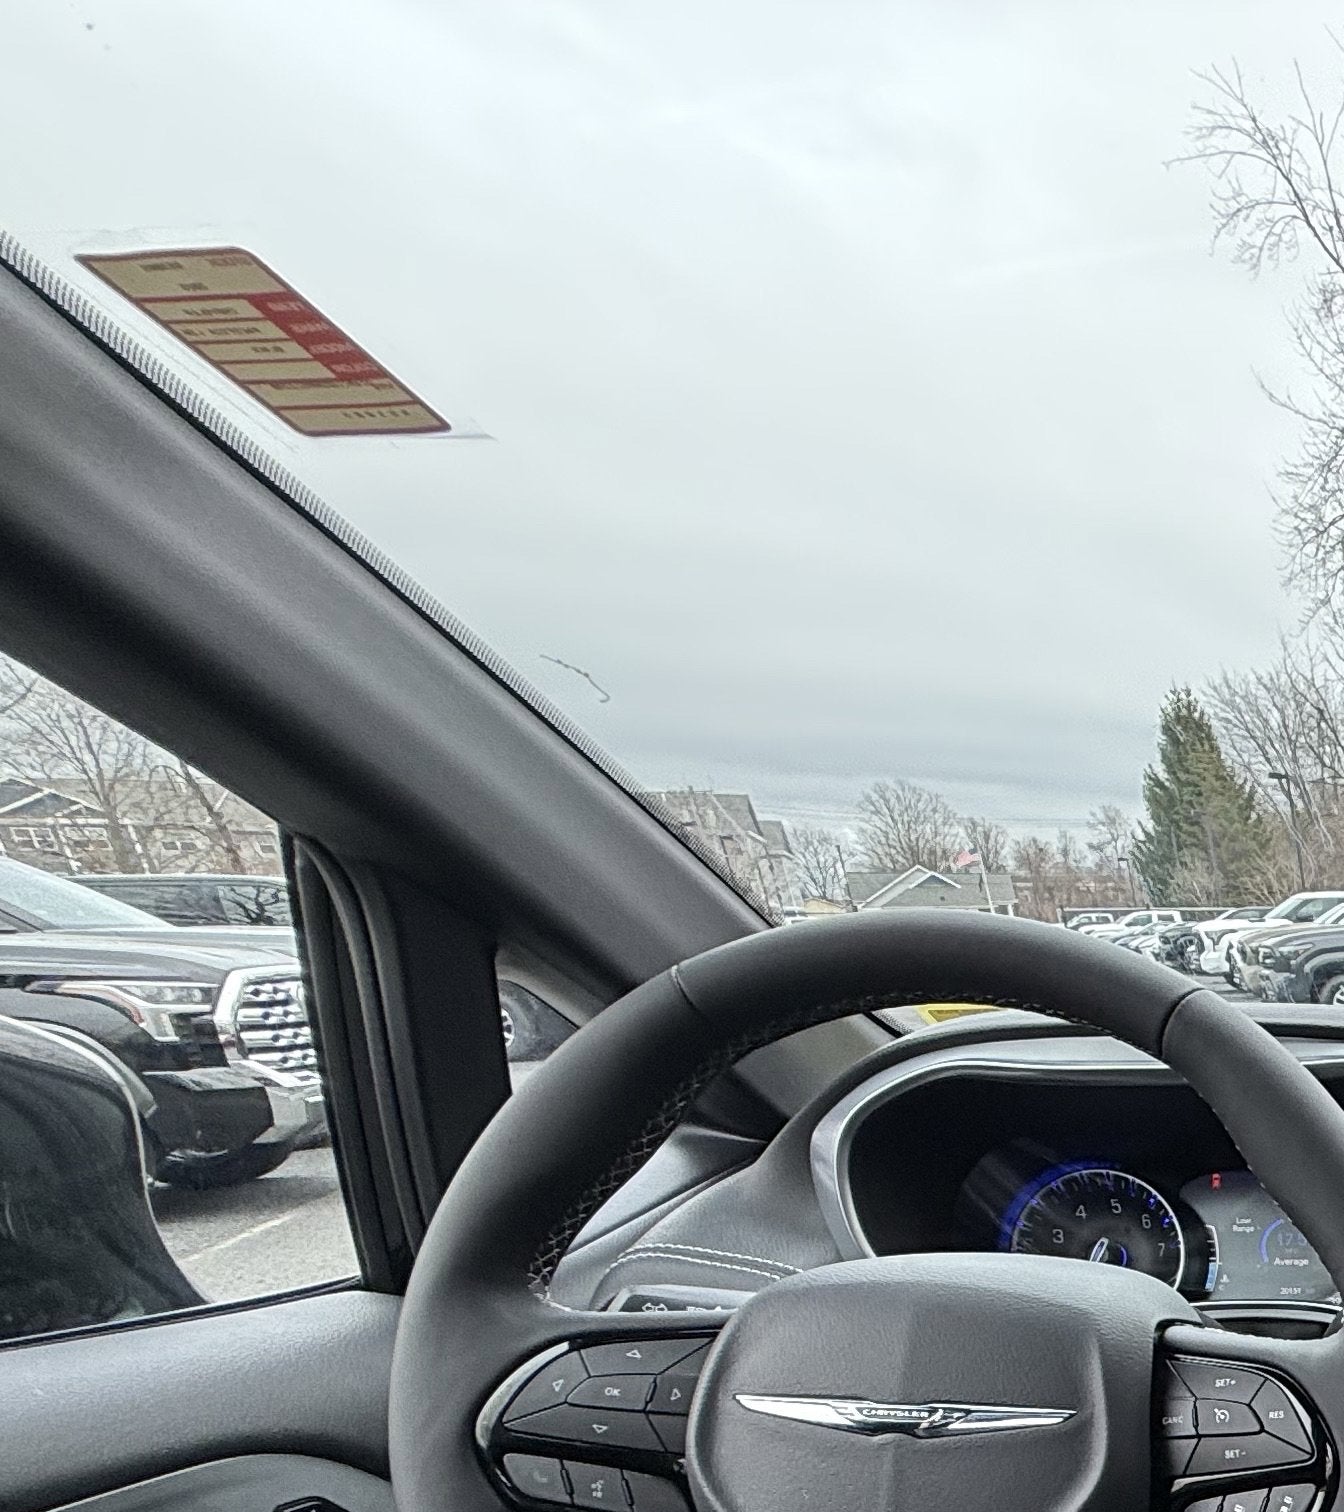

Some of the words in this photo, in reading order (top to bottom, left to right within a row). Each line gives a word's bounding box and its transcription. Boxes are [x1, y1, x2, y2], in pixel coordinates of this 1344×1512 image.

[1075, 1204, 1087, 1219] 4
[1110, 1199, 1122, 1214] 5
[1142, 1214, 1151, 1229] 6
[1053, 1229, 1064, 1244] 3
[1157, 1242, 1166, 1257] 7
[1273, 1257, 1309, 1267] Average
[604, 1387, 621, 1397] OK
[1268, 1410, 1284, 1419] RES
